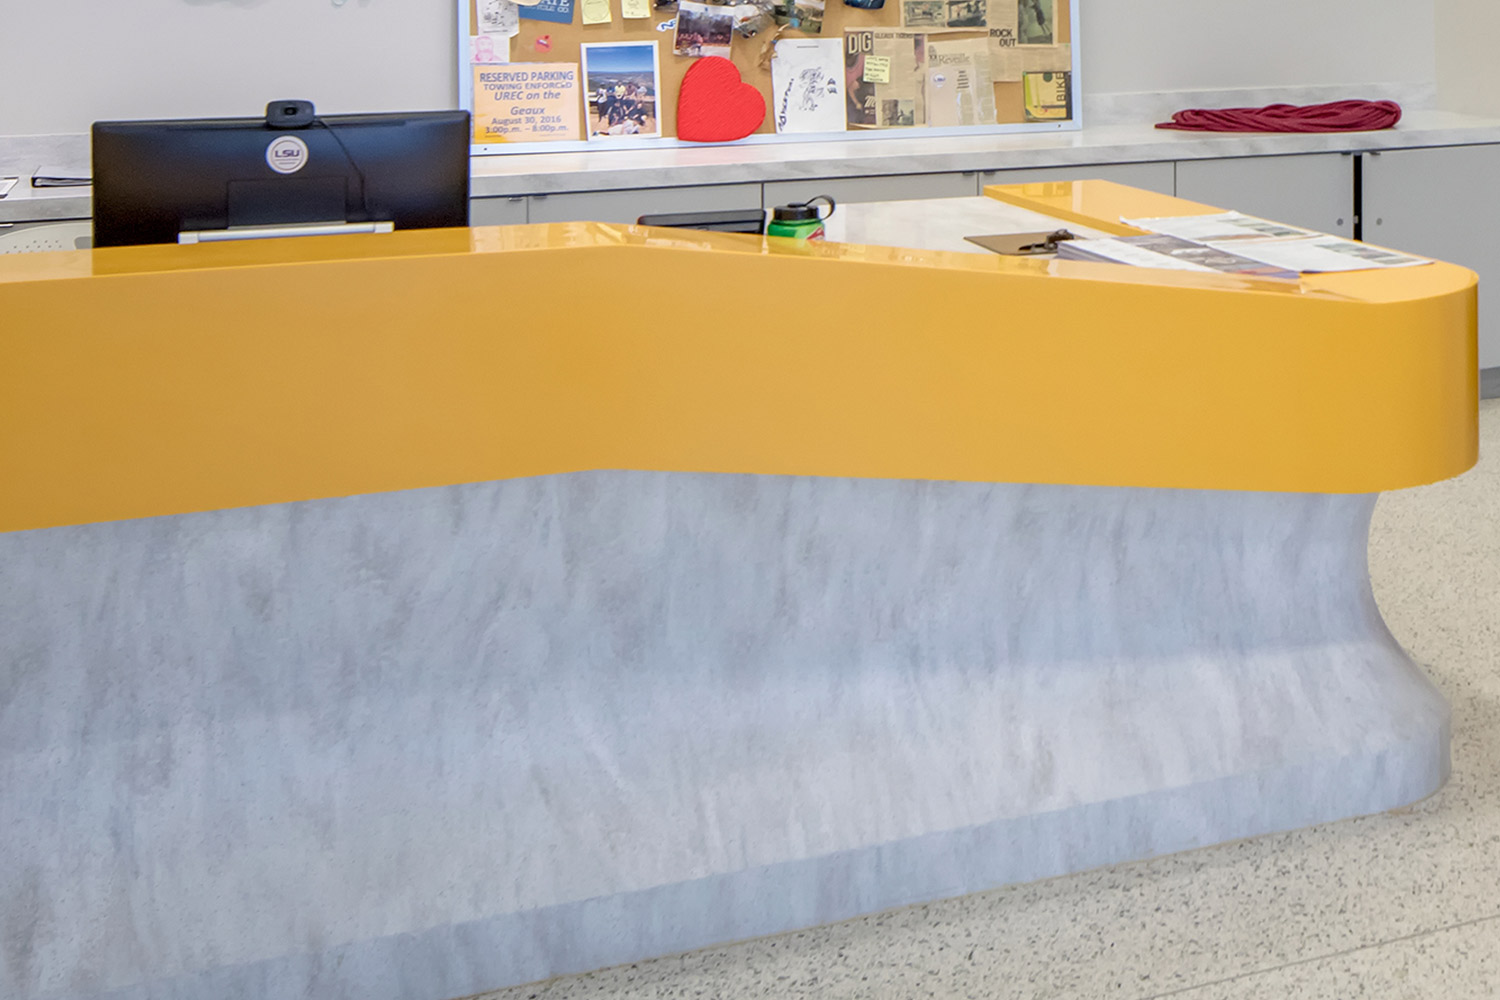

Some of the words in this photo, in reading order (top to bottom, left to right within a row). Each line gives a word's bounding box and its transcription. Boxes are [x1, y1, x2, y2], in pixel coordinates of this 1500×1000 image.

[989, 28, 1012, 37] ROCK
[848, 32, 871, 54] DIG
[999, 38, 1016, 47] OUT
[480, 72, 528, 82] RESERVED
[530, 71, 574, 81] PARKING
[483, 83, 522, 91] TOWING
[1056, 72, 1066, 102] BIKE
[494, 91, 524, 101] UREC
[543, 90, 561, 99] the
[510, 106, 545, 115] Geaux
[491, 117, 522, 126] August
[275, 149, 300, 158] LSU
